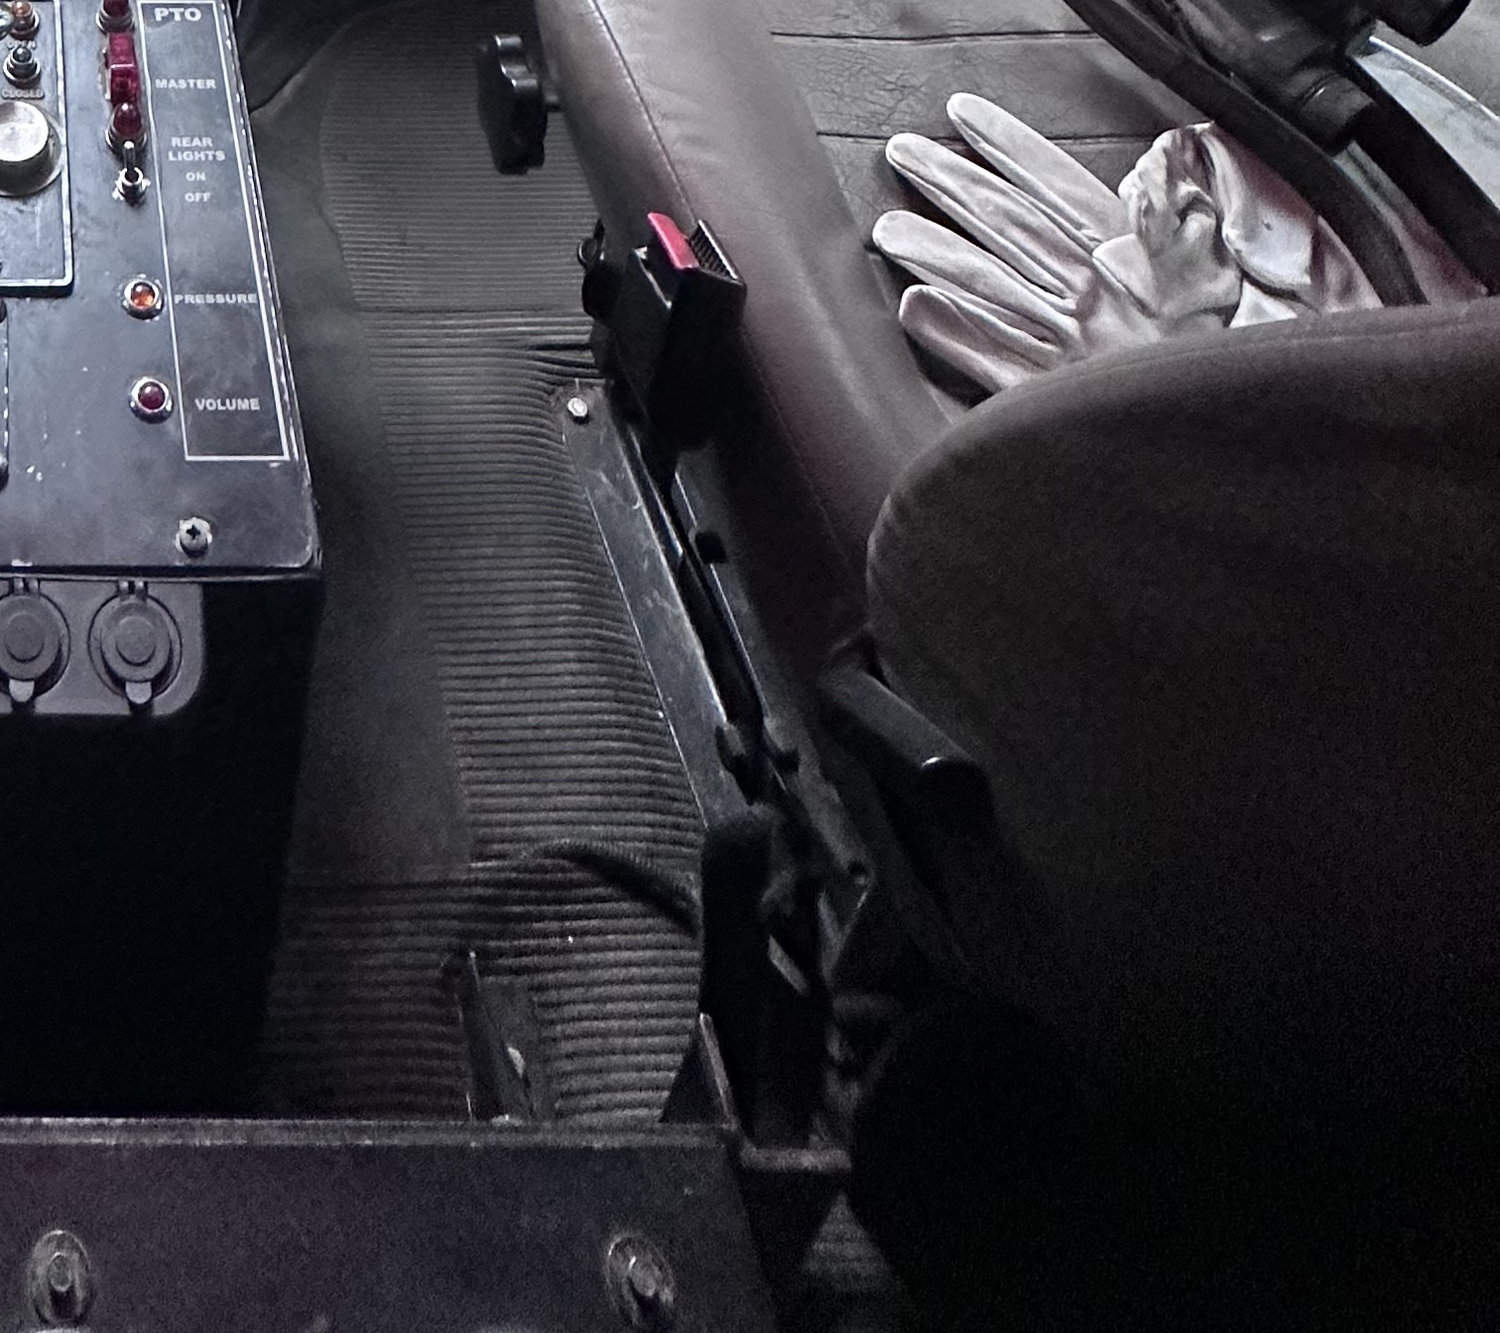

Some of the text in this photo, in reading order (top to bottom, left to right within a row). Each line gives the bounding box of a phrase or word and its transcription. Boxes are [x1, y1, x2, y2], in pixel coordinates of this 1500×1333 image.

[154, 7, 202, 21] PTO
[155, 78, 217, 89] MASTER
[1, 88, 45, 99] CLOSED
[171, 137, 214, 147] REAR
[168, 150, 226, 162] LIGHTS
[186, 171, 206, 181] ON
[184, 192, 211, 202] OFF
[174, 293, 258, 304] PRESSURE
[194, 398, 260, 411] VOLUME
